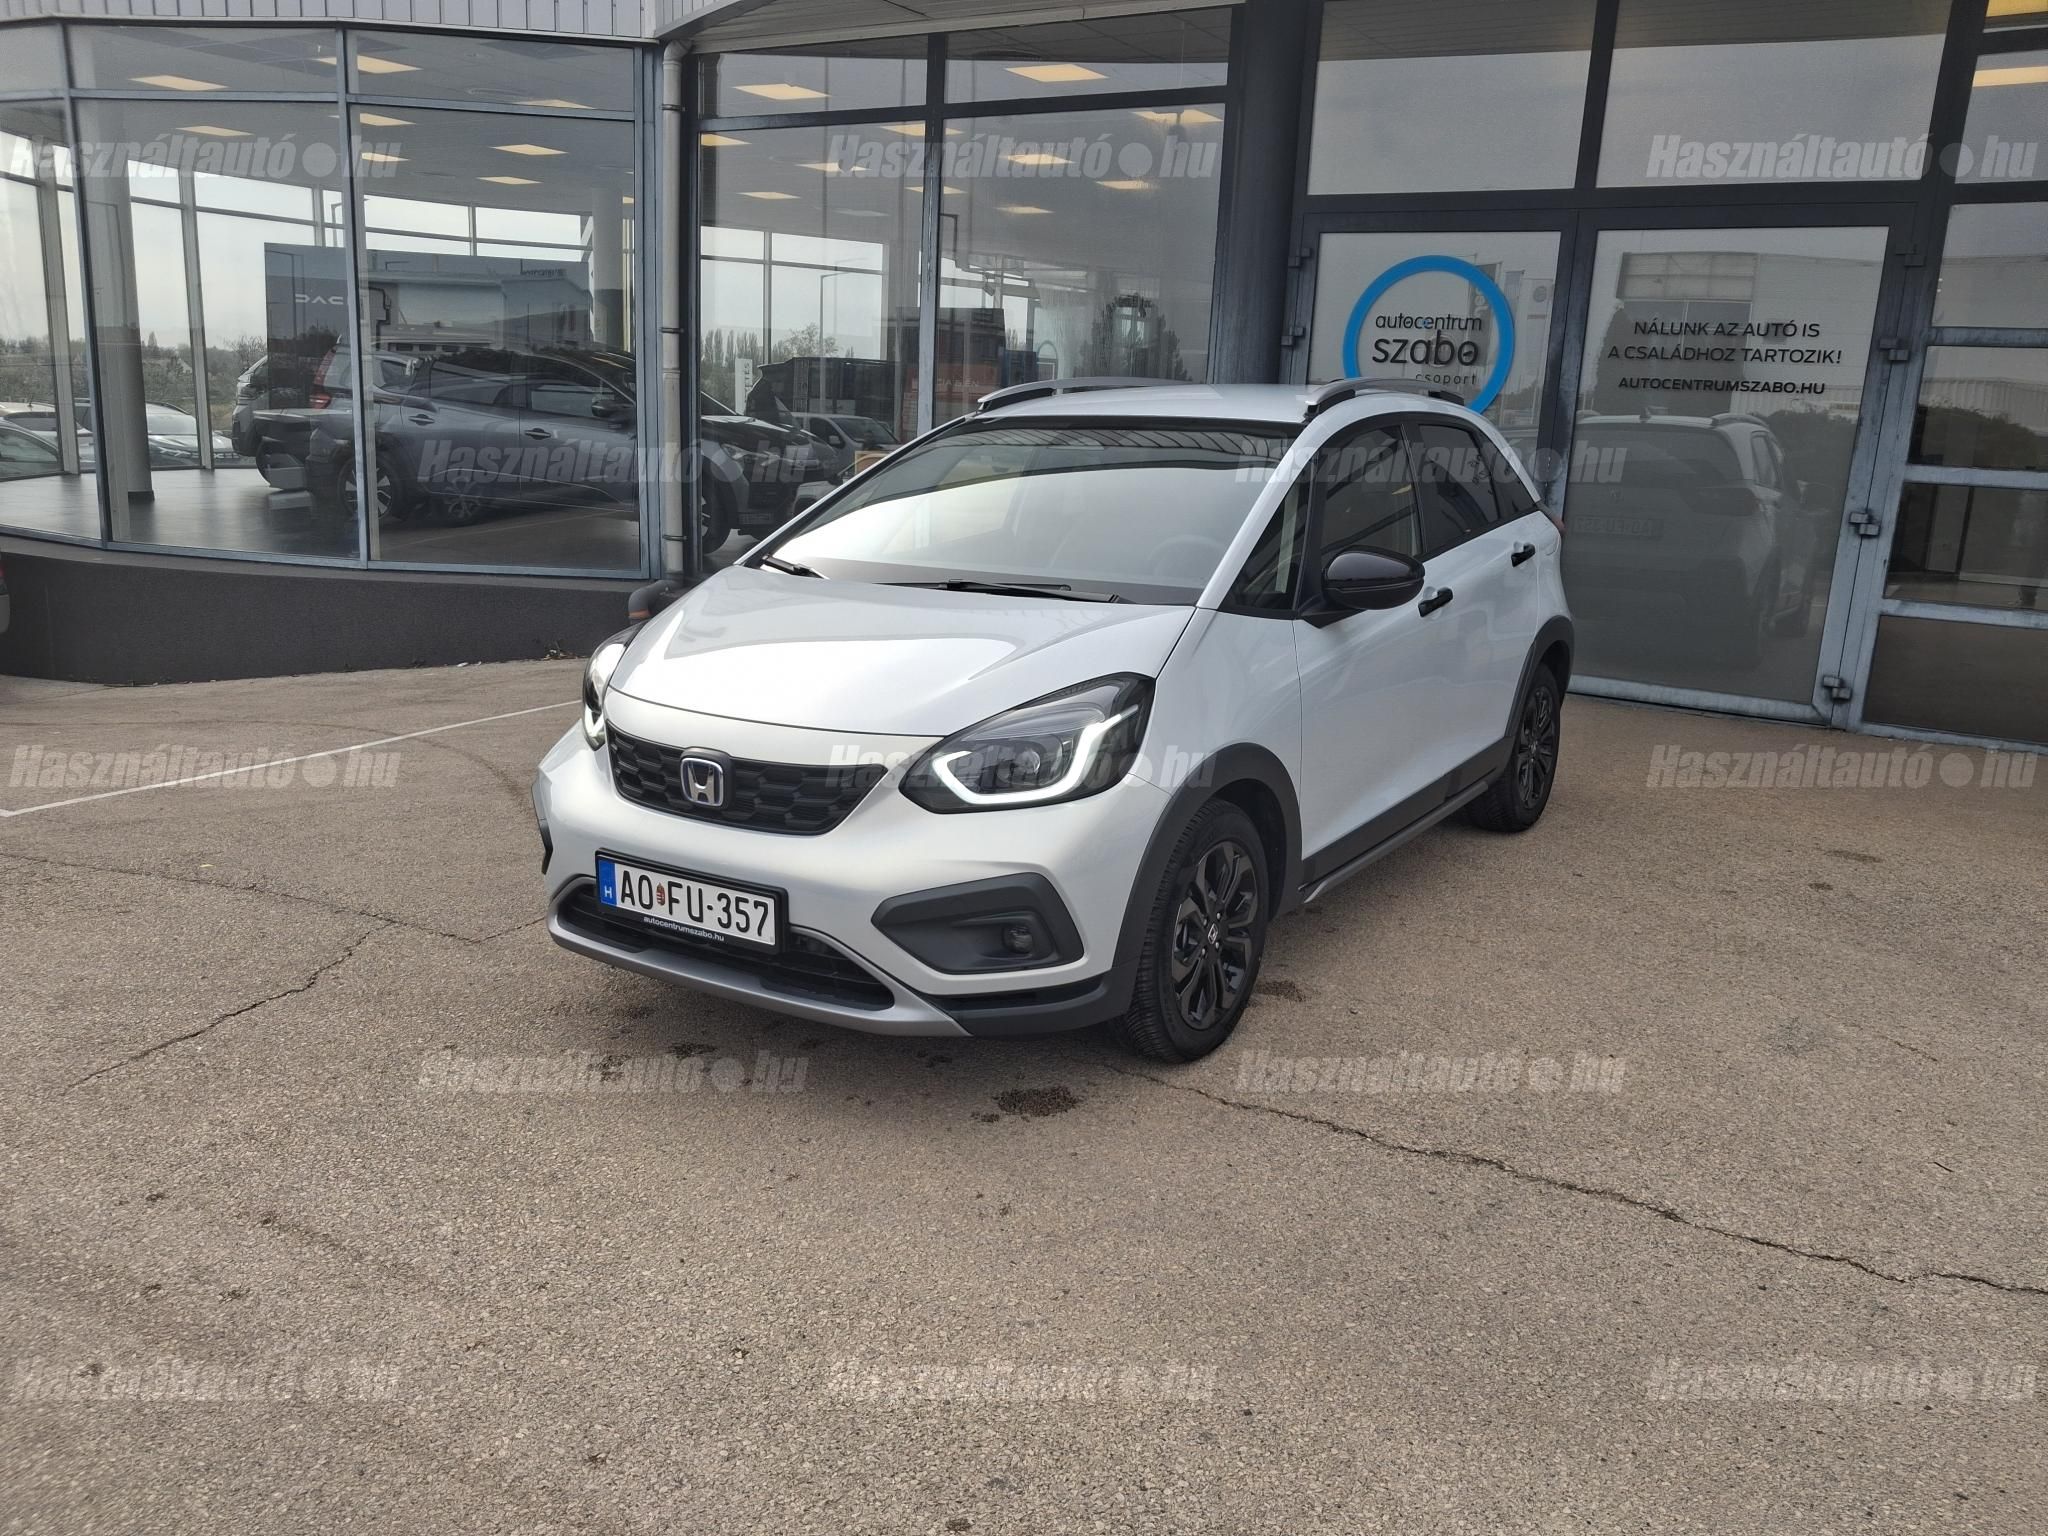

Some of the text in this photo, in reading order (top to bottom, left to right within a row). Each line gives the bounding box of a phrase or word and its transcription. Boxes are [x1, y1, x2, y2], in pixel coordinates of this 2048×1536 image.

[1375, 312, 1483, 332] autocentrum
[1634, 318, 1821, 338] NÁLUNK AZ AUTÓ IS
[1607, 344, 1842, 364] A CSALÁDHOZ TARTOZIK!
[1618, 377, 1825, 395] AUTOCENTRUMSZABO.HU
[621, 870, 654, 910] AO
[667, 881, 769, 937] FU-357
[643, 916, 725, 942] autocentrumszabo.hu
